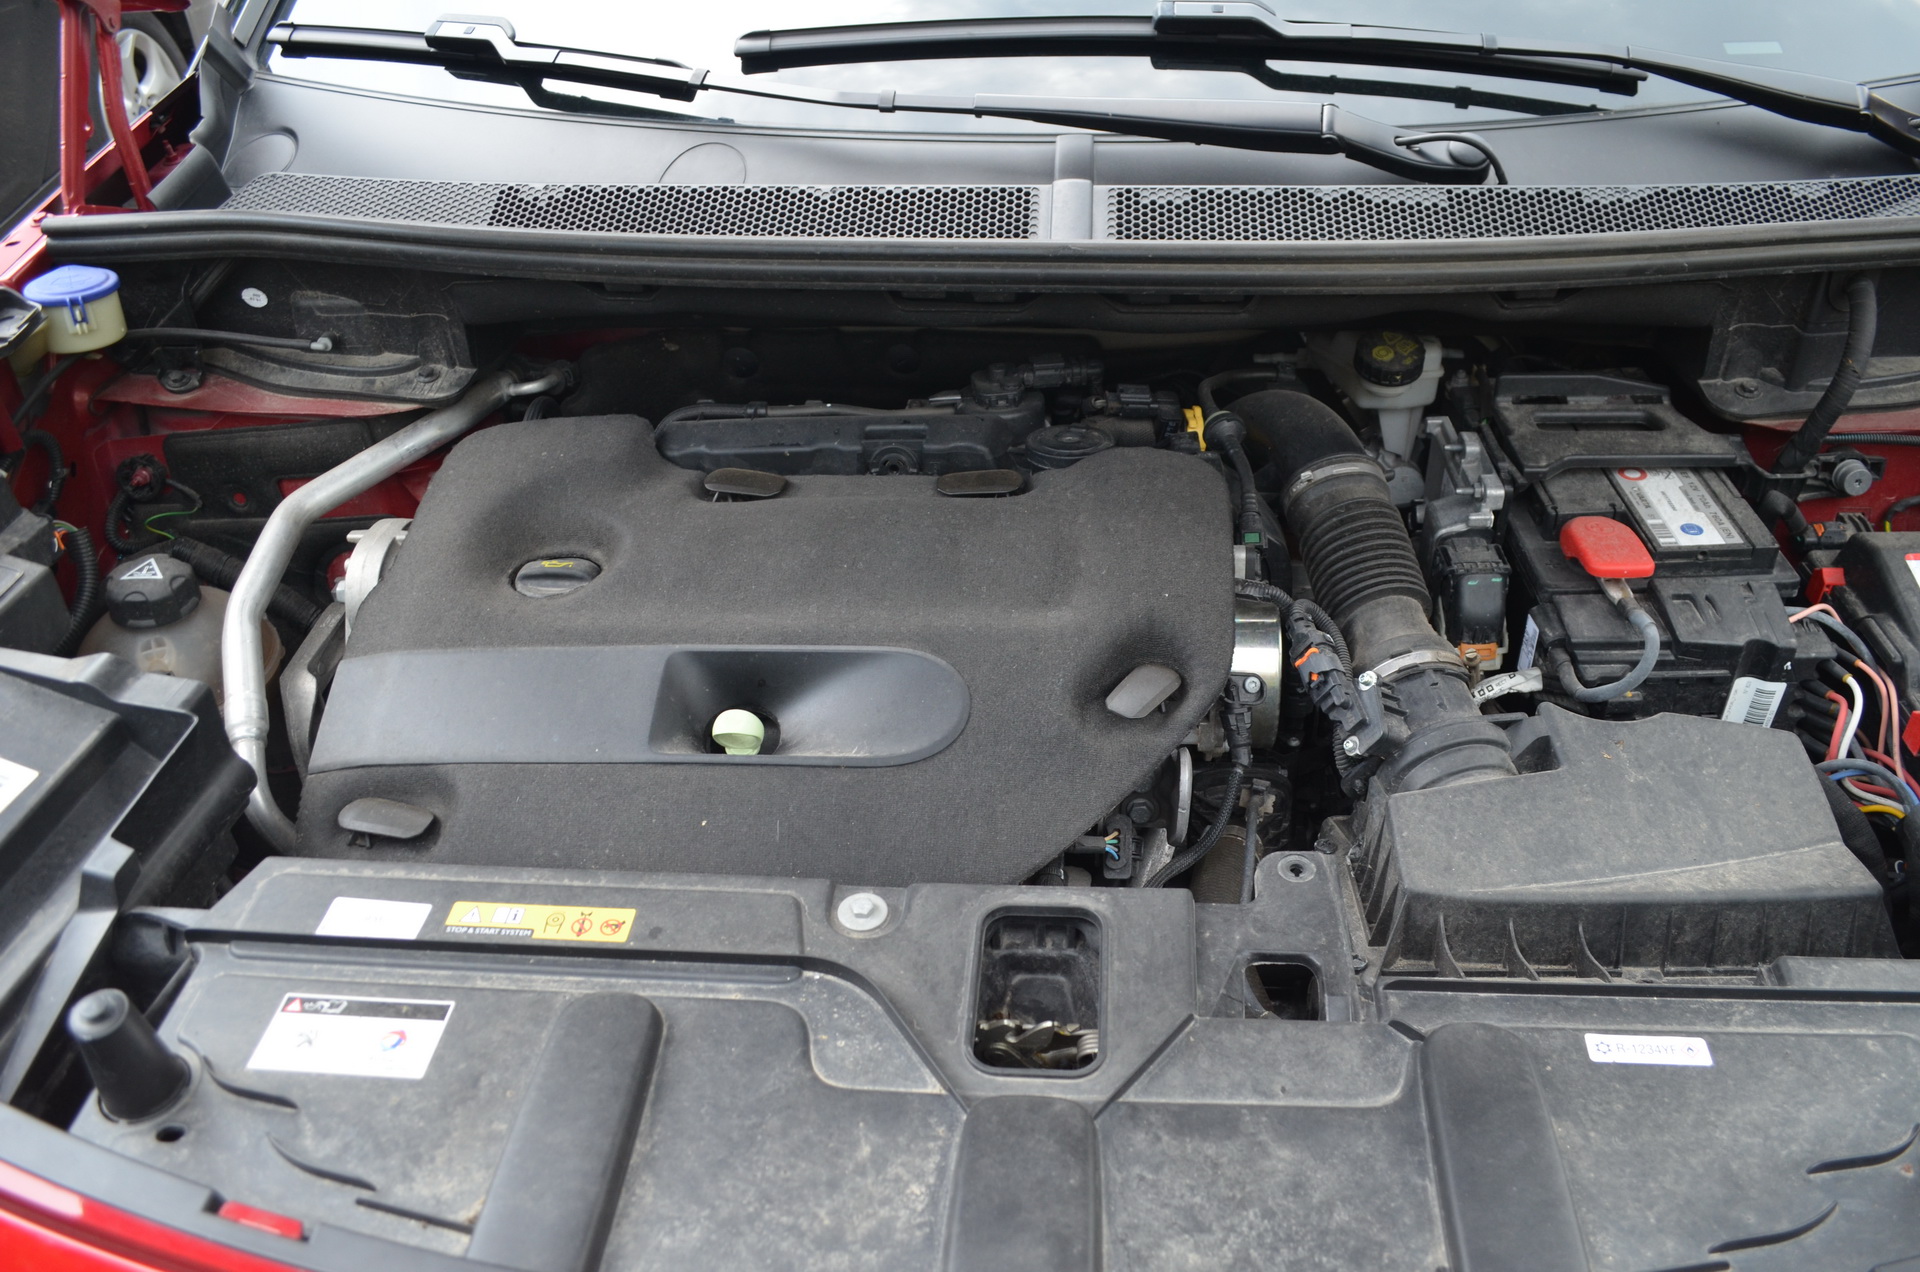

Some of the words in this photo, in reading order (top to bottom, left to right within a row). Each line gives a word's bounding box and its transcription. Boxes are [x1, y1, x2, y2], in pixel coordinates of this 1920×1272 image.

[1688, 481, 1701, 492] 12V
[1698, 494, 1711, 509] 70Ah
[475, 927, 498, 935] START
[1616, 1043, 1676, 1055] R-1234YF
